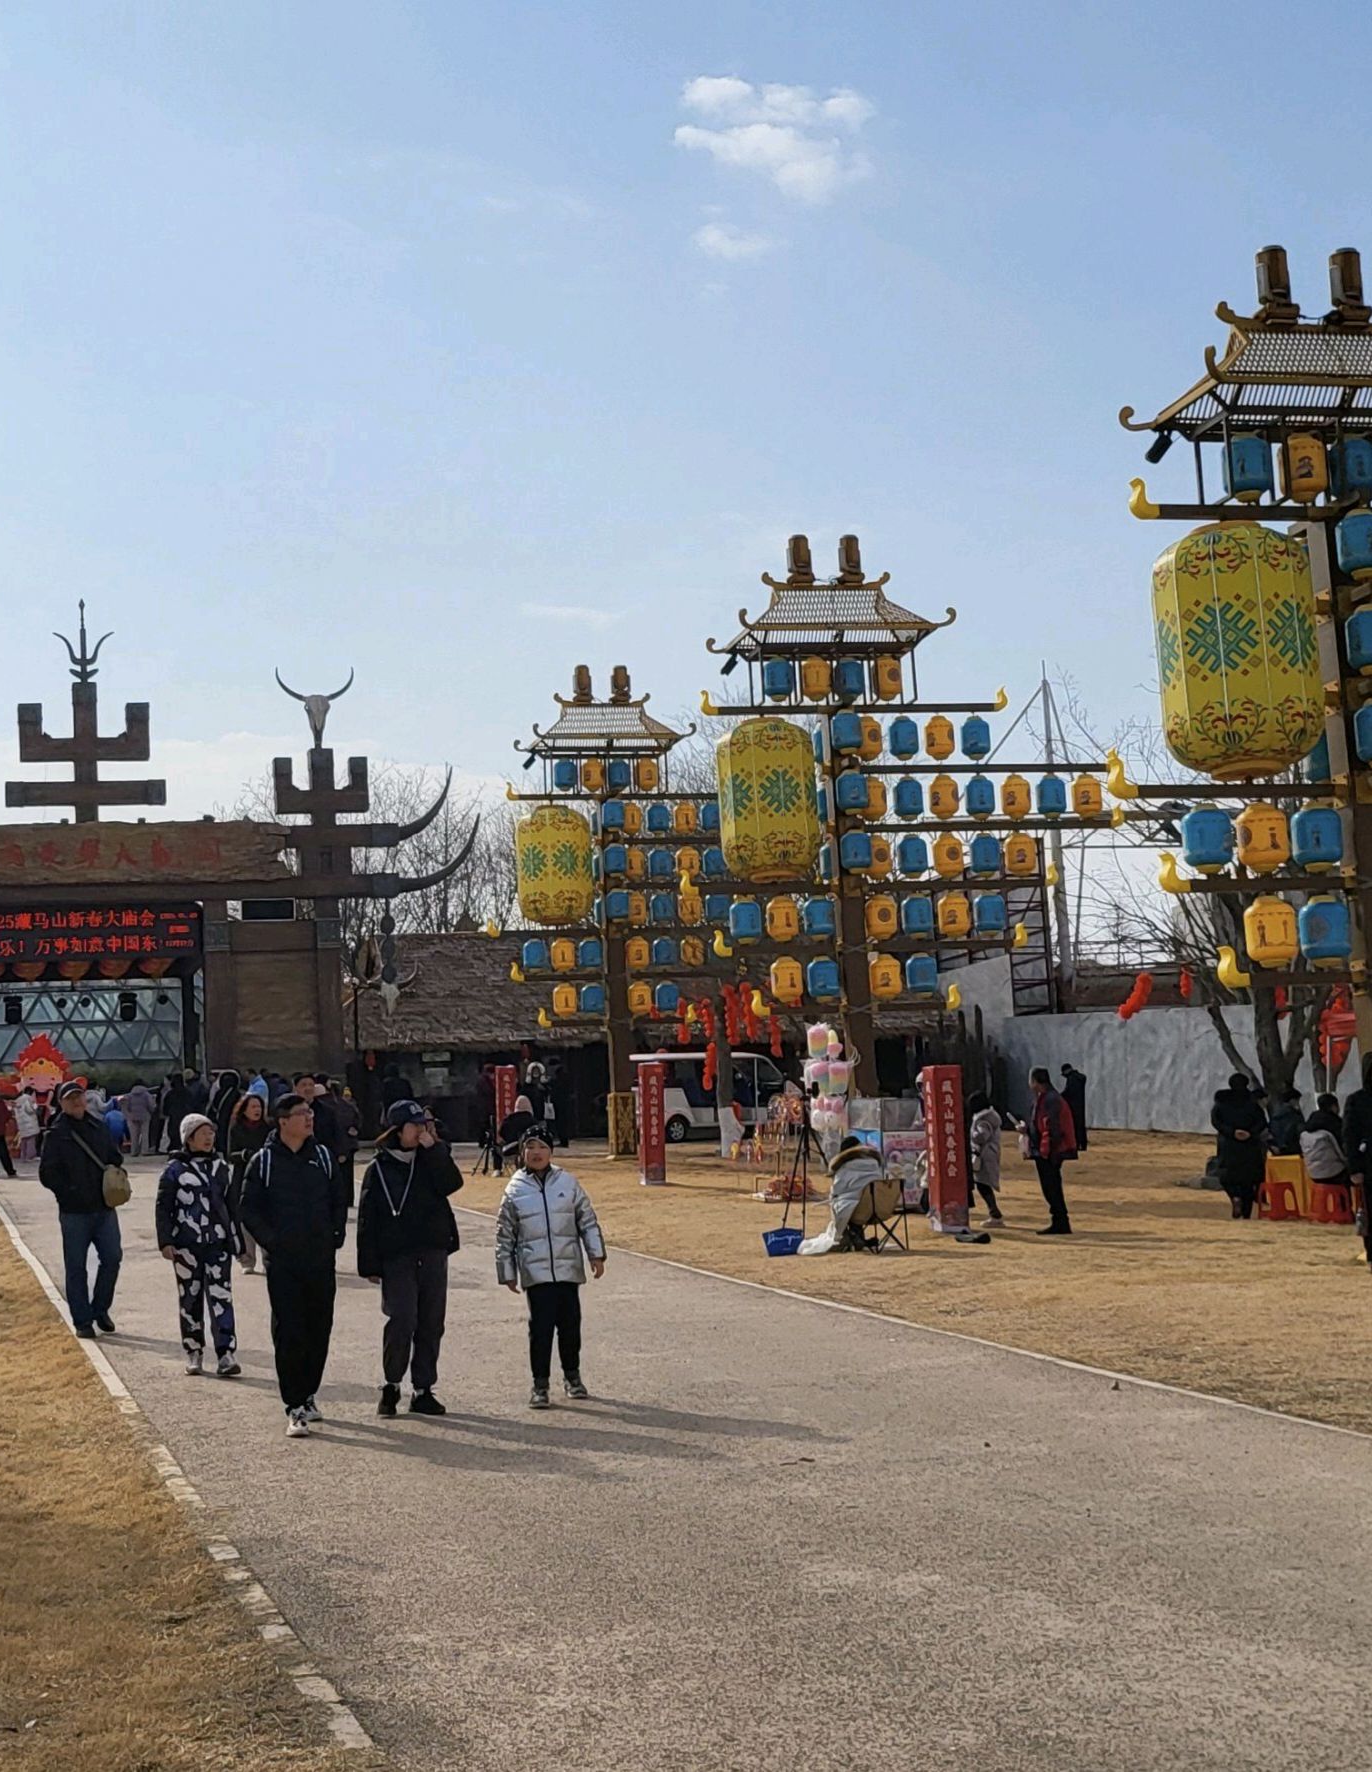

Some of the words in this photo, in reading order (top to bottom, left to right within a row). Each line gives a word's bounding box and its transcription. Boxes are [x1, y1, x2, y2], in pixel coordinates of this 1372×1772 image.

[34, 935, 163, 955] 万事如意中国东
[941, 1080, 958, 1177] 藏马山新春庙会
